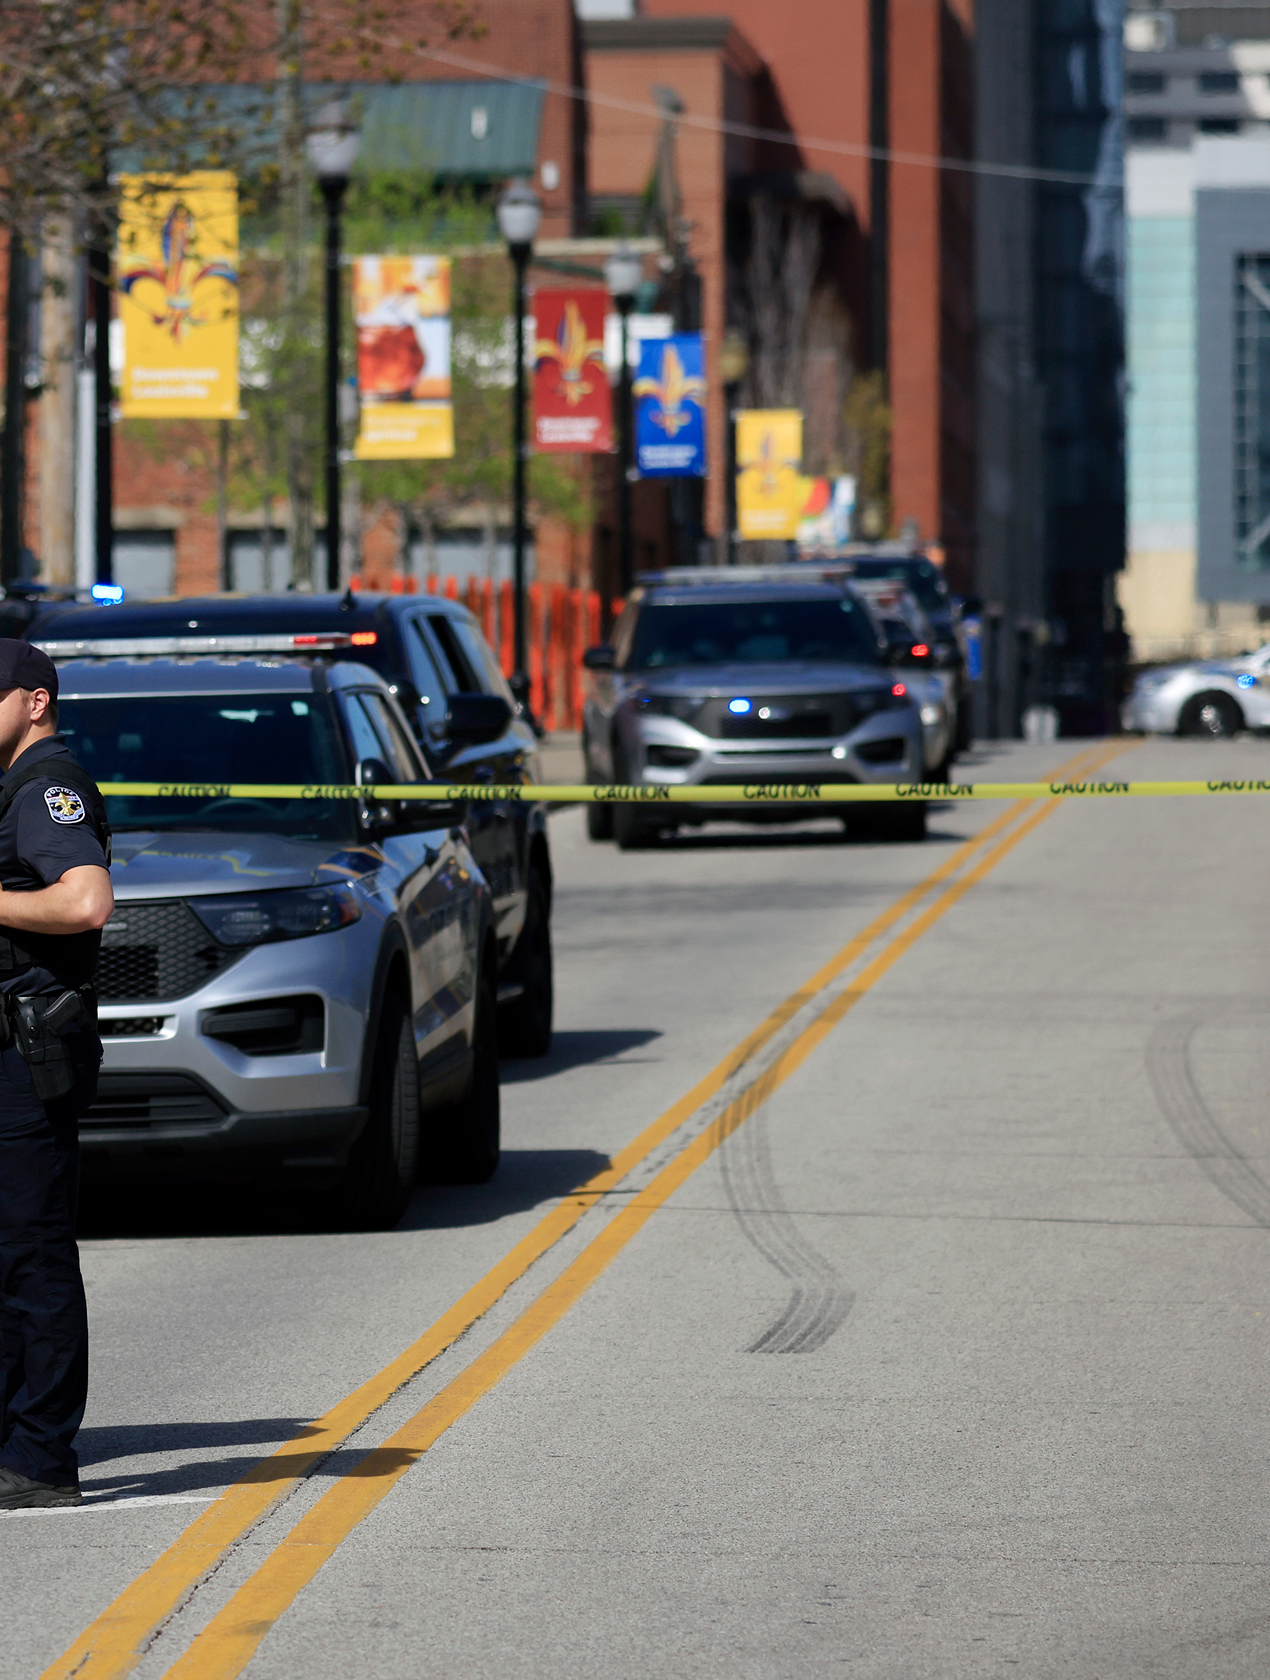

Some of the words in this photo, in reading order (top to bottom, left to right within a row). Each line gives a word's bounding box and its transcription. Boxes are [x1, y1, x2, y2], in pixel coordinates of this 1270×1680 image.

[158, 786, 231, 798] CAUTION
[302, 786, 376, 799] CAUTION
[446, 786, 521, 800] CAUTION
[594, 786, 670, 800] CAUTION
[743, 784, 821, 799] CAUTION
[895, 784, 973, 797] CAUTION
[1049, 782, 1129, 794] CAUTION
